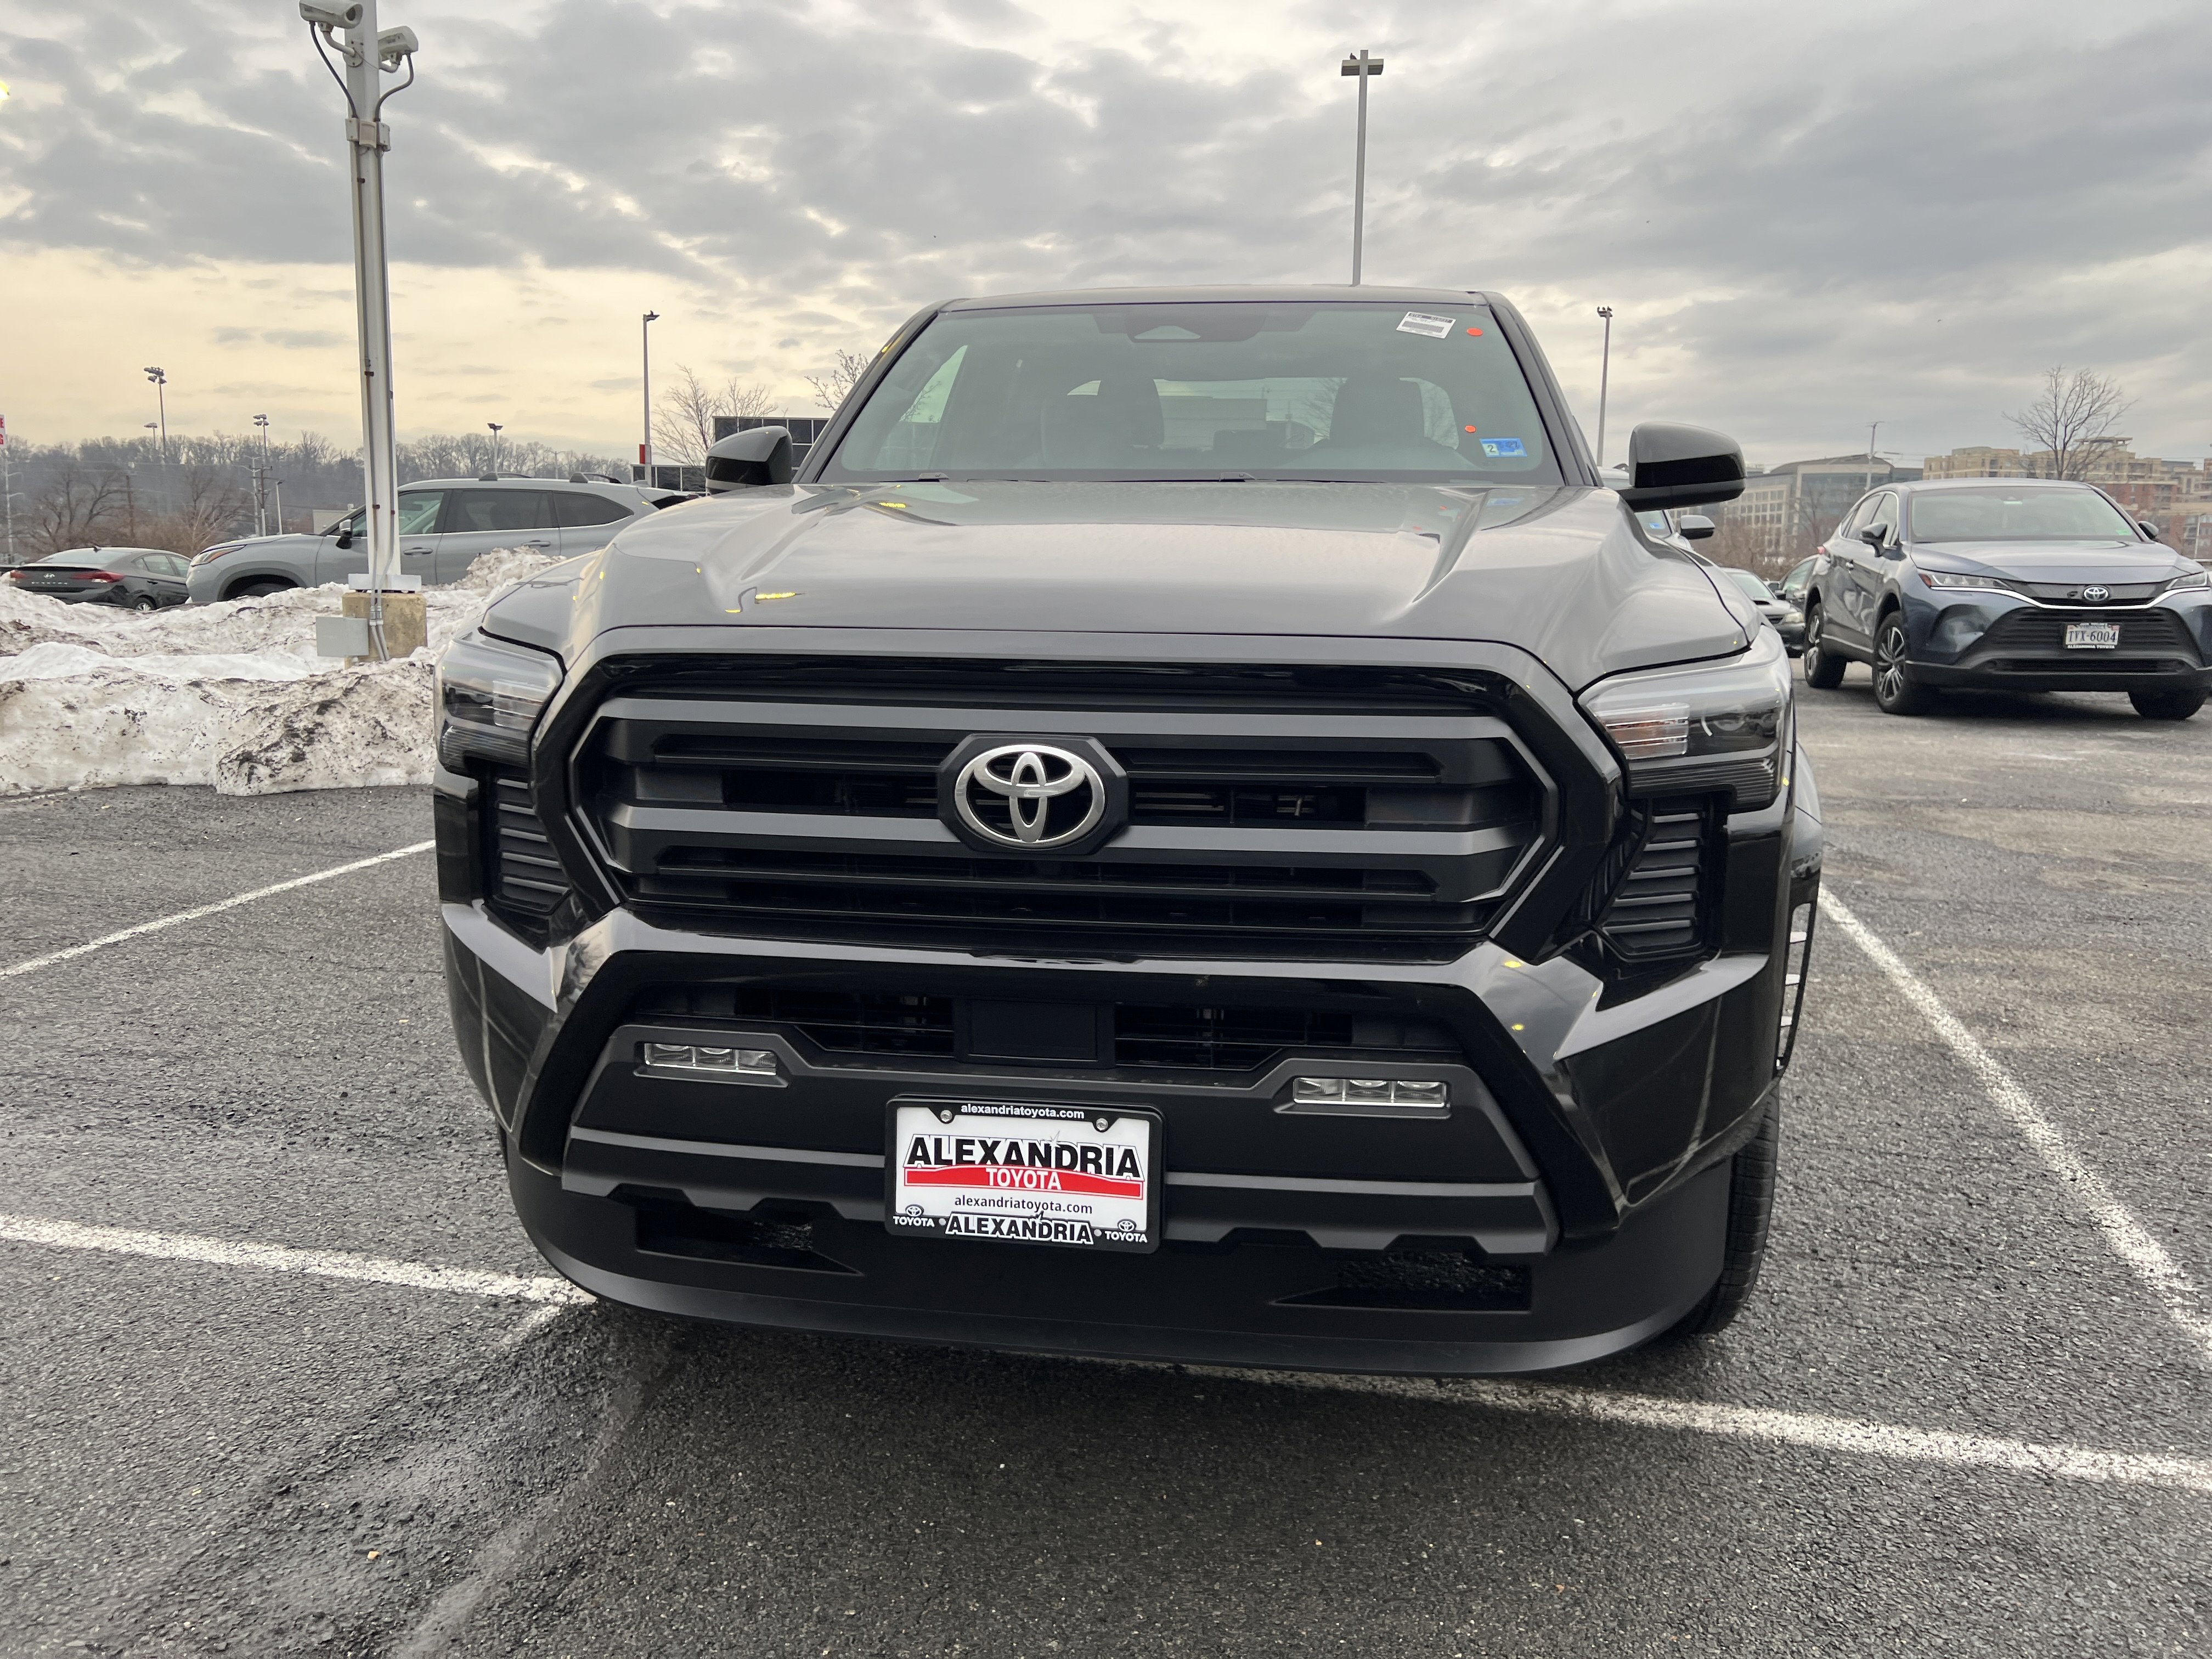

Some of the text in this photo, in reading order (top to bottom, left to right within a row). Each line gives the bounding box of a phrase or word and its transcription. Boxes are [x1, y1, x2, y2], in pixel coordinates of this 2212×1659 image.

[961, 1104, 1085, 1119] alexandriatoyota.com
[906, 1136, 1142, 1178] ALEXANDRIA
[986, 1168, 1062, 1190] TOYOTA
[954, 1194, 1093, 1215] alexandriatoyota.com
[893, 1215, 1148, 1243] TOYOTA ALEXANDRIA TOYOTA
